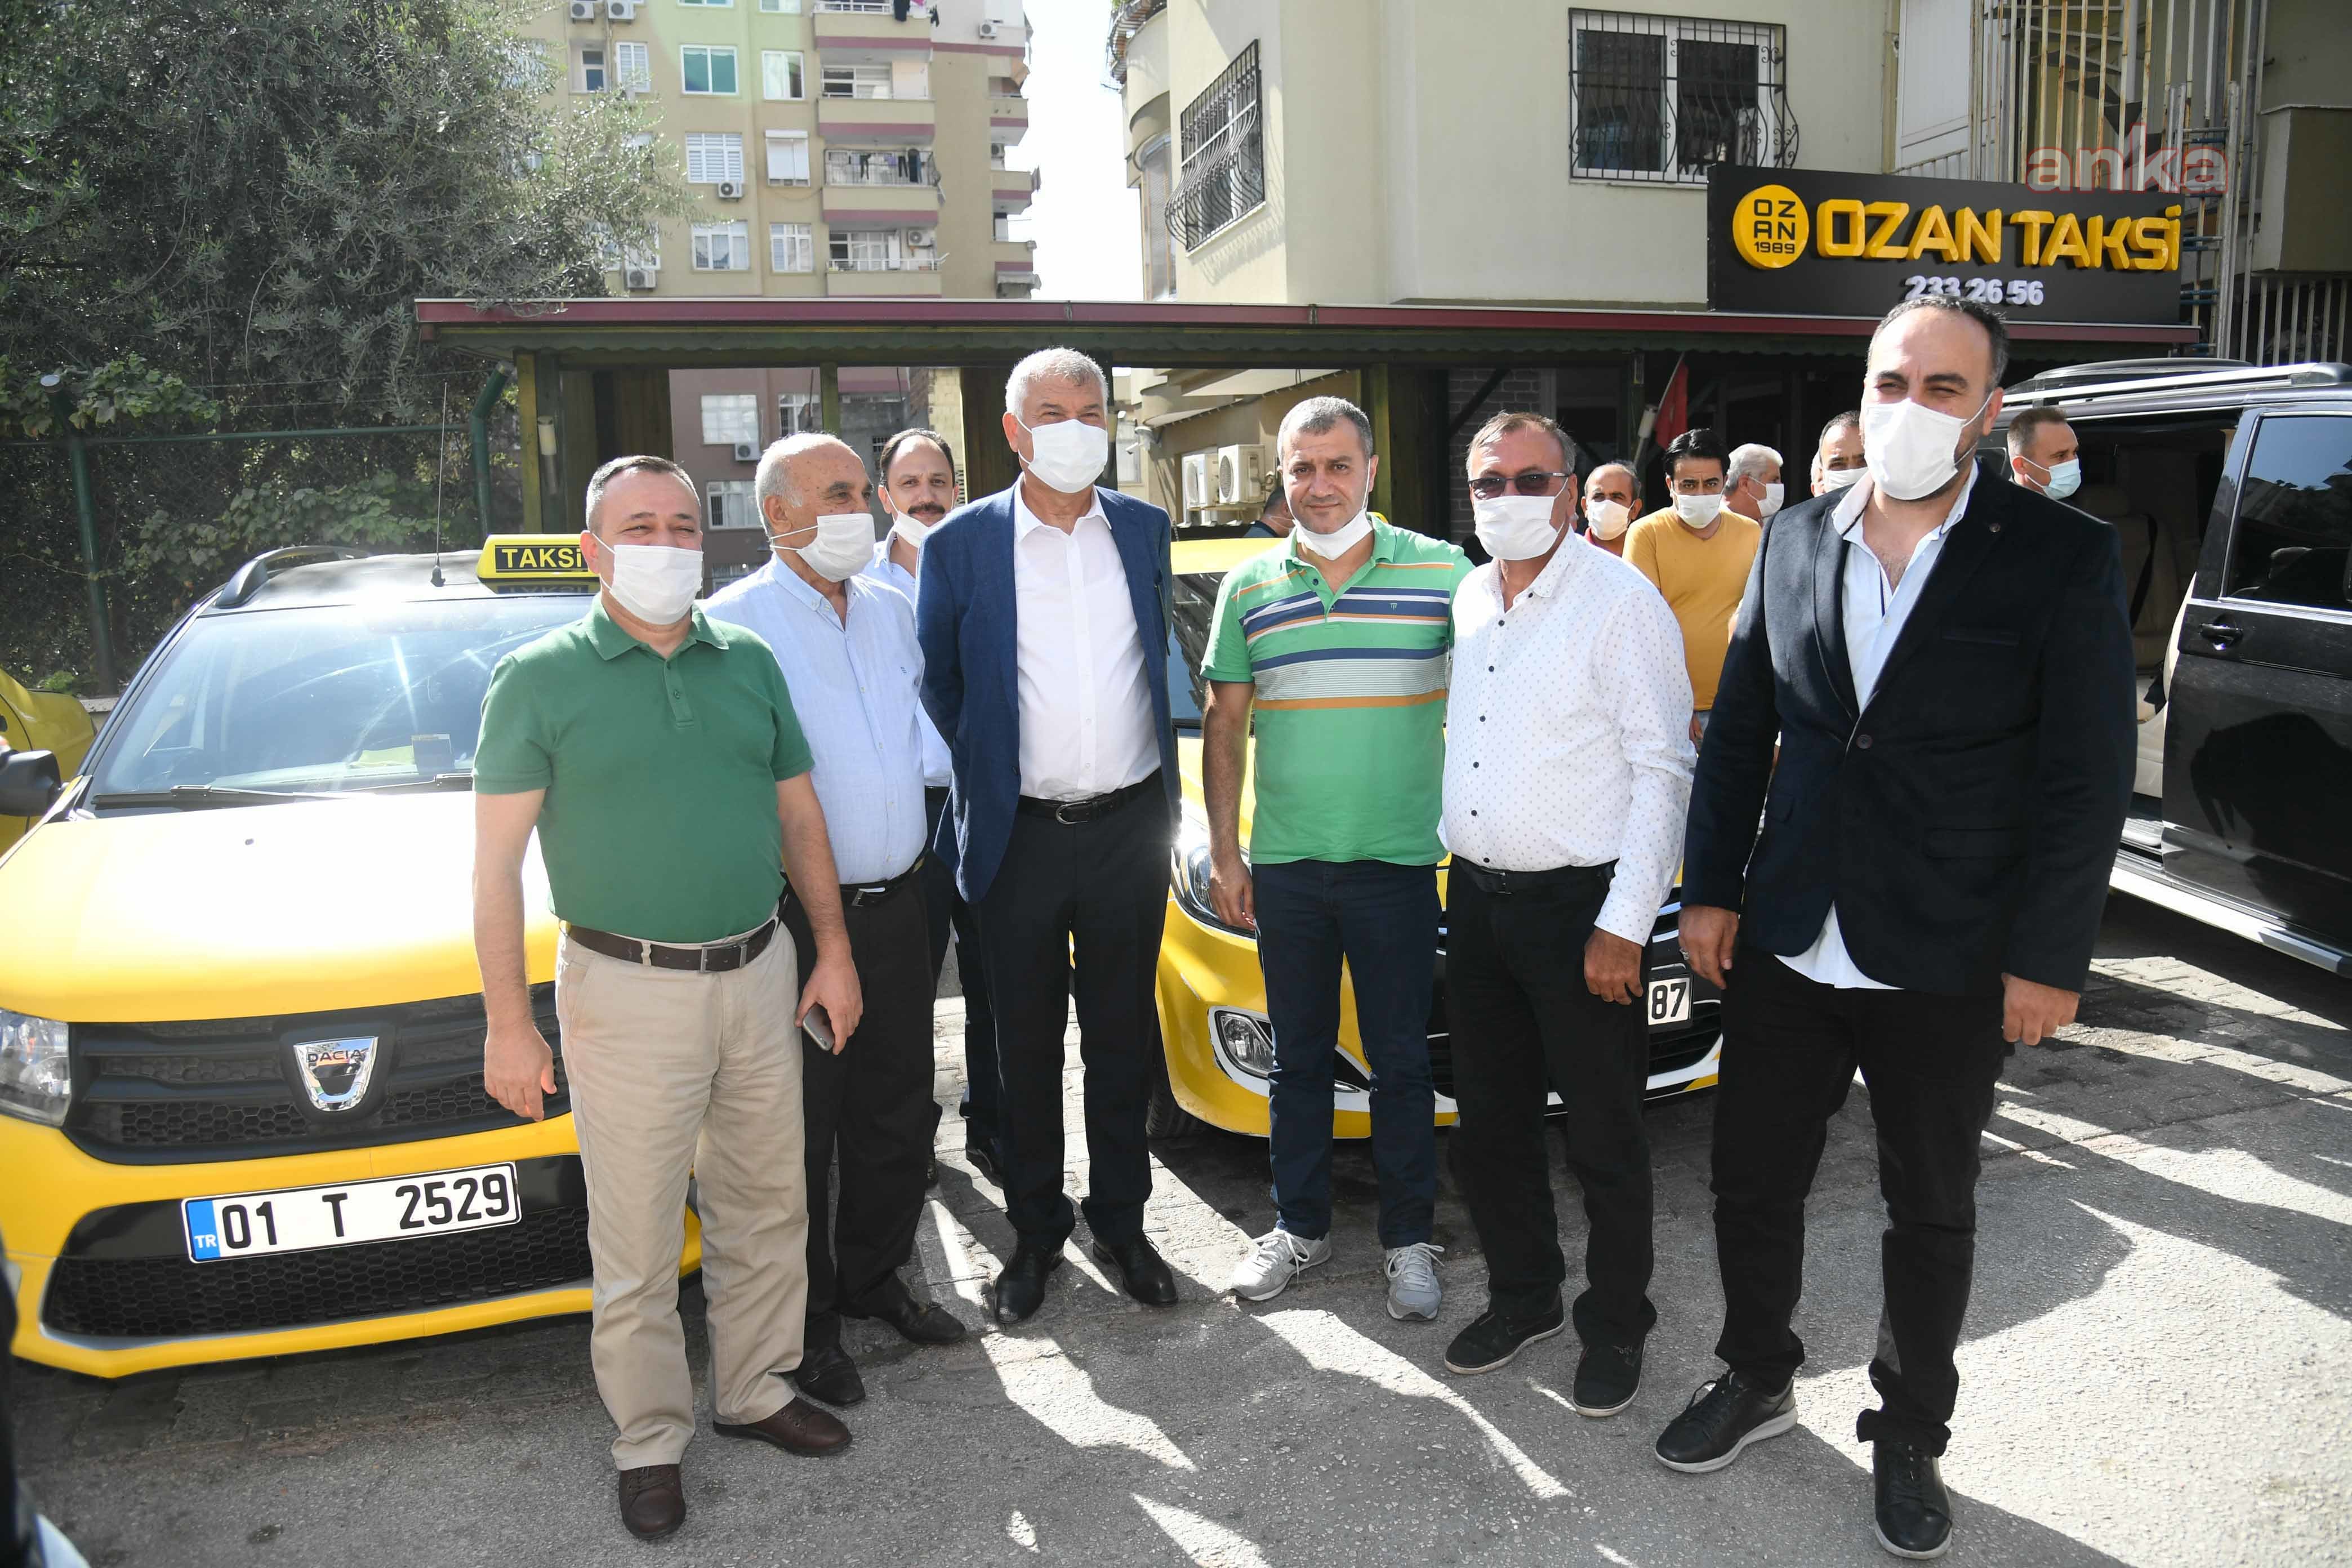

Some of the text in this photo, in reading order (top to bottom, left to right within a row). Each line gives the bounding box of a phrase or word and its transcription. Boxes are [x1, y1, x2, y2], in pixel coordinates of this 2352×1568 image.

[1754, 242, 1795, 254] 1989
[1817, 199, 2002, 264] OZAN
[1905, 275, 2044, 305] 233 26 56
[1651, 982, 1687, 1019] 87
[308, 1049, 362, 1062] DACIA
[194, 1173, 510, 1250] TR 01 T 2529
